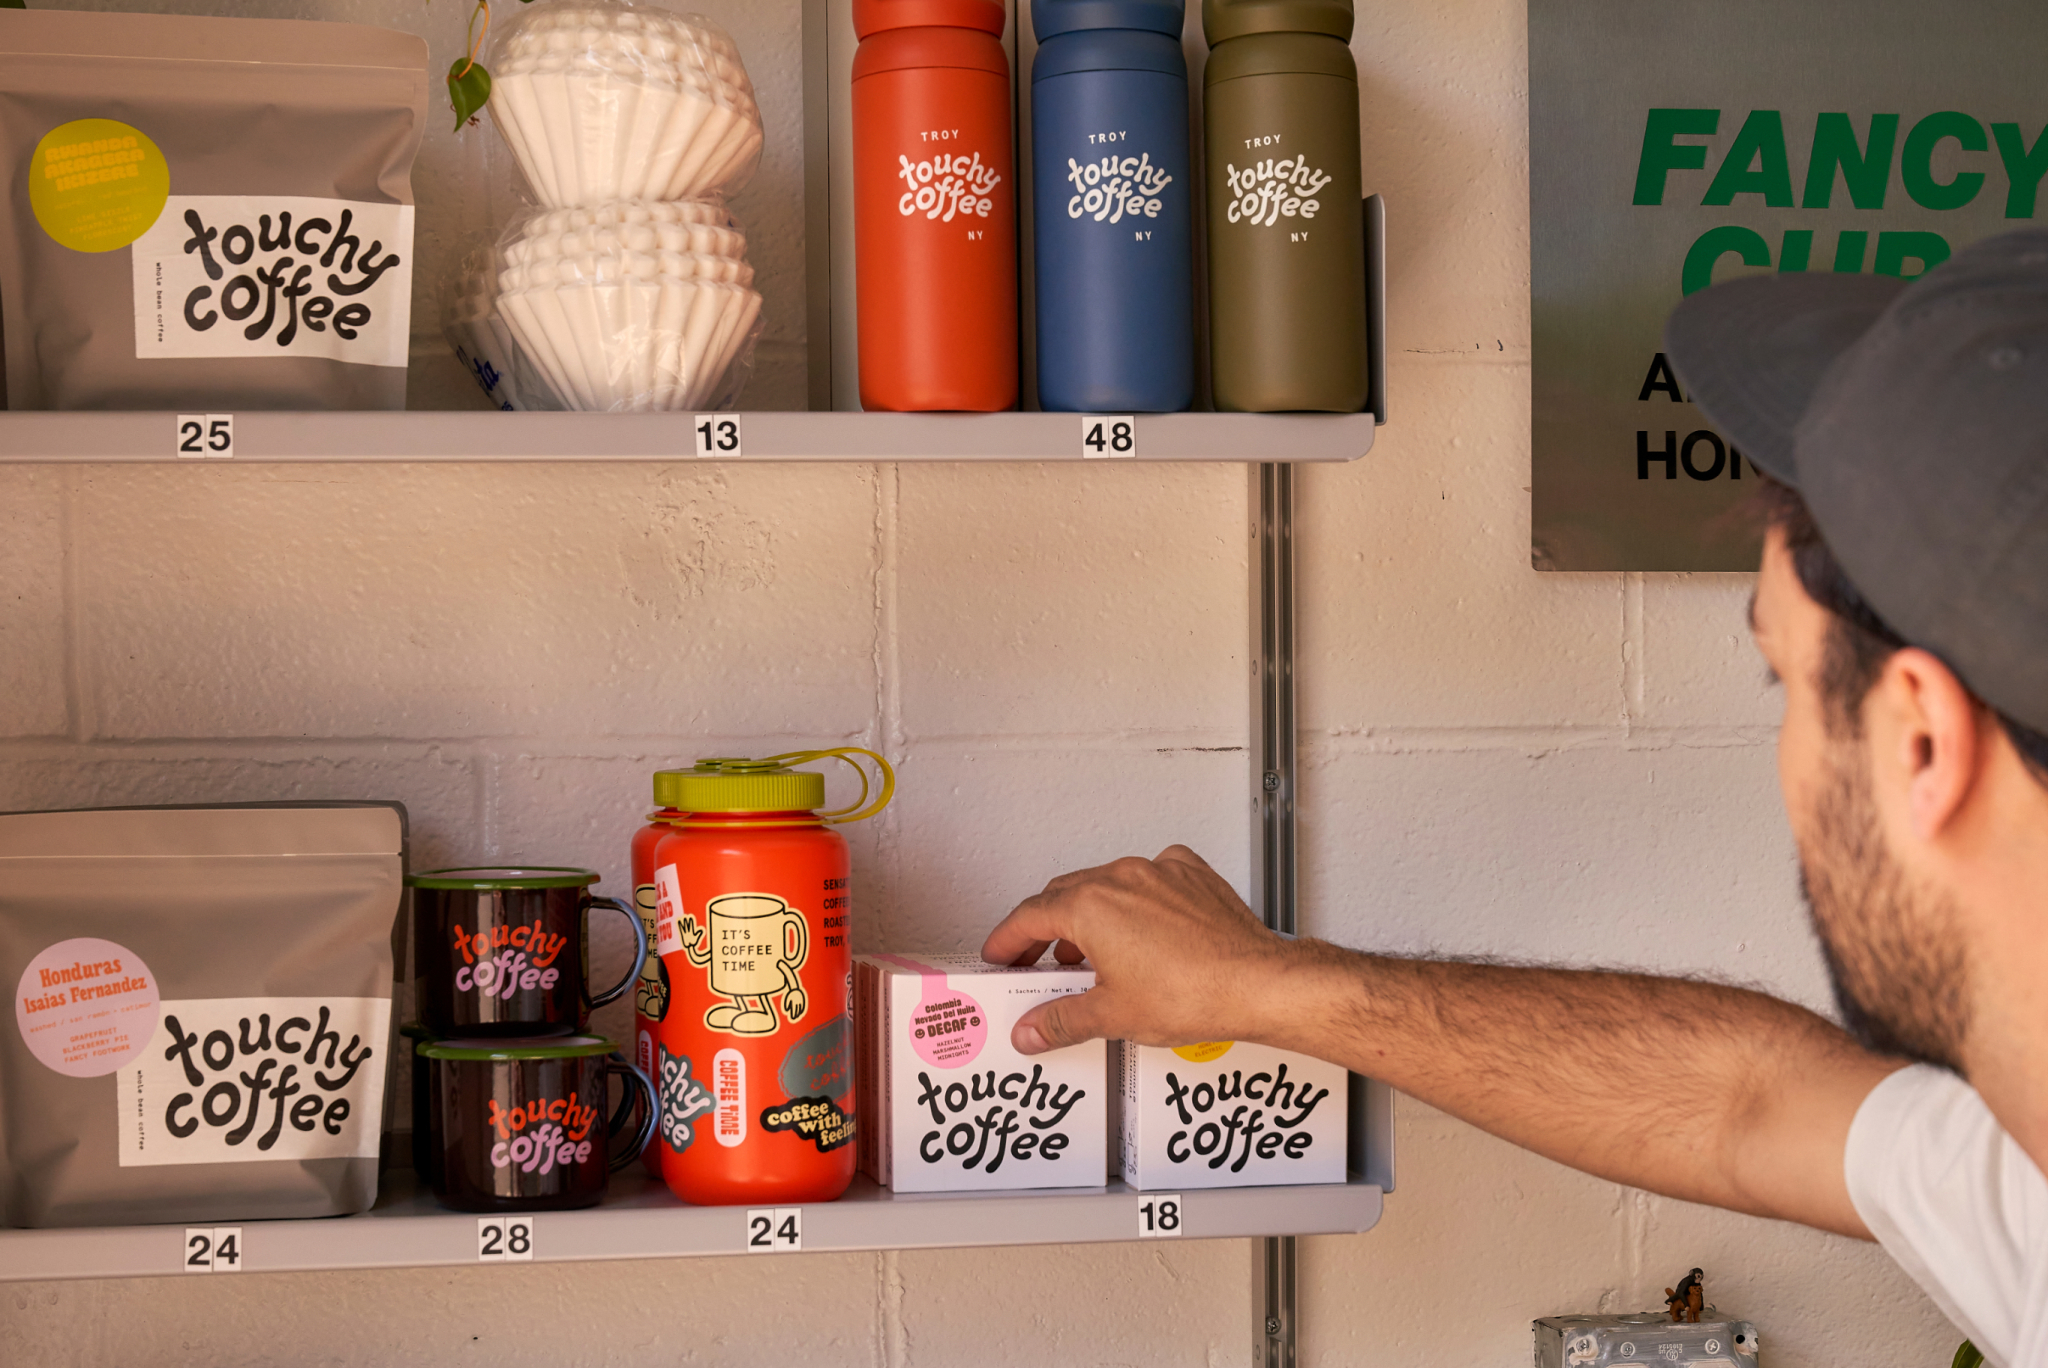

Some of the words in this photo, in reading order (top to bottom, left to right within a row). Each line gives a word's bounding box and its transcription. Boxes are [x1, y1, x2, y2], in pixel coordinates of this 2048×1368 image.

[921, 129, 959, 142] TROY
[1089, 131, 1127, 144] TROY
[1245, 134, 1281, 149] TROY
[899, 151, 1001, 196] touchy
[1068, 152, 1172, 196] touchy
[1227, 154, 1332, 198] touchy
[1633, 108, 2048, 218] FANCY
[899, 176, 993, 223] coffee
[1068, 177, 1162, 224] coffee
[1227, 180, 1320, 227] coffee
[968, 231, 983, 240] NY
[1135, 231, 1152, 241] NY
[1291, 232, 1308, 242] NY
[184, 209, 400, 296] touchy
[184, 257, 371, 346] coffee
[180, 421, 231, 452] 25
[697, 421, 739, 451] 13
[1085, 422, 1133, 452] 48
[453, 919, 567, 968] touchy
[722, 929, 751, 940] IT'S
[722, 945, 773, 956] COFFEE
[39, 959, 122, 988] Honduras
[456, 949, 559, 1000] coffee
[723, 960, 756, 972] TIME
[23, 993, 67, 1014] Isaias
[69, 976, 147, 1003] Fernandez
[925, 998, 962, 1013] Colombia
[915, 1013, 942, 1025] Nevado
[943, 1009, 956, 1019] Del
[927, 1017, 967, 1037] DECAF
[63, 1039, 109, 1054] BLACKBERRY
[114, 1034, 129, 1043] PIE
[70, 1027, 117, 1043] GRAPEFRUIT
[164, 1005, 372, 1091] touchy
[933, 1042, 971, 1055] MARSHMALLOW
[937, 1037, 964, 1047] HAZELNUT
[64, 1053, 88, 1064] FANCY
[93, 1044, 130, 1057] FOOTWORK
[938, 1050, 969, 1061] MIDNIGHTS
[1194, 1045, 1222, 1057] ELECTRIC
[719, 1060, 739, 1102] COFFEE
[1165, 1063, 1329, 1128] touchy
[165, 1058, 350, 1151] coffee
[918, 1064, 1085, 1129] touchy
[488, 1092, 597, 1142] touchy
[767, 1102, 829, 1127] coffee
[798, 1111, 842, 1134] with
[491, 1123, 592, 1175] coffee
[920, 1106, 1069, 1173] coffee
[1167, 1105, 1313, 1173] coffee
[750, 1215, 799, 1246] 24
[1140, 1201, 1179, 1230] 18
[187, 1234, 240, 1266] 24
[481, 1224, 531, 1255] 28
